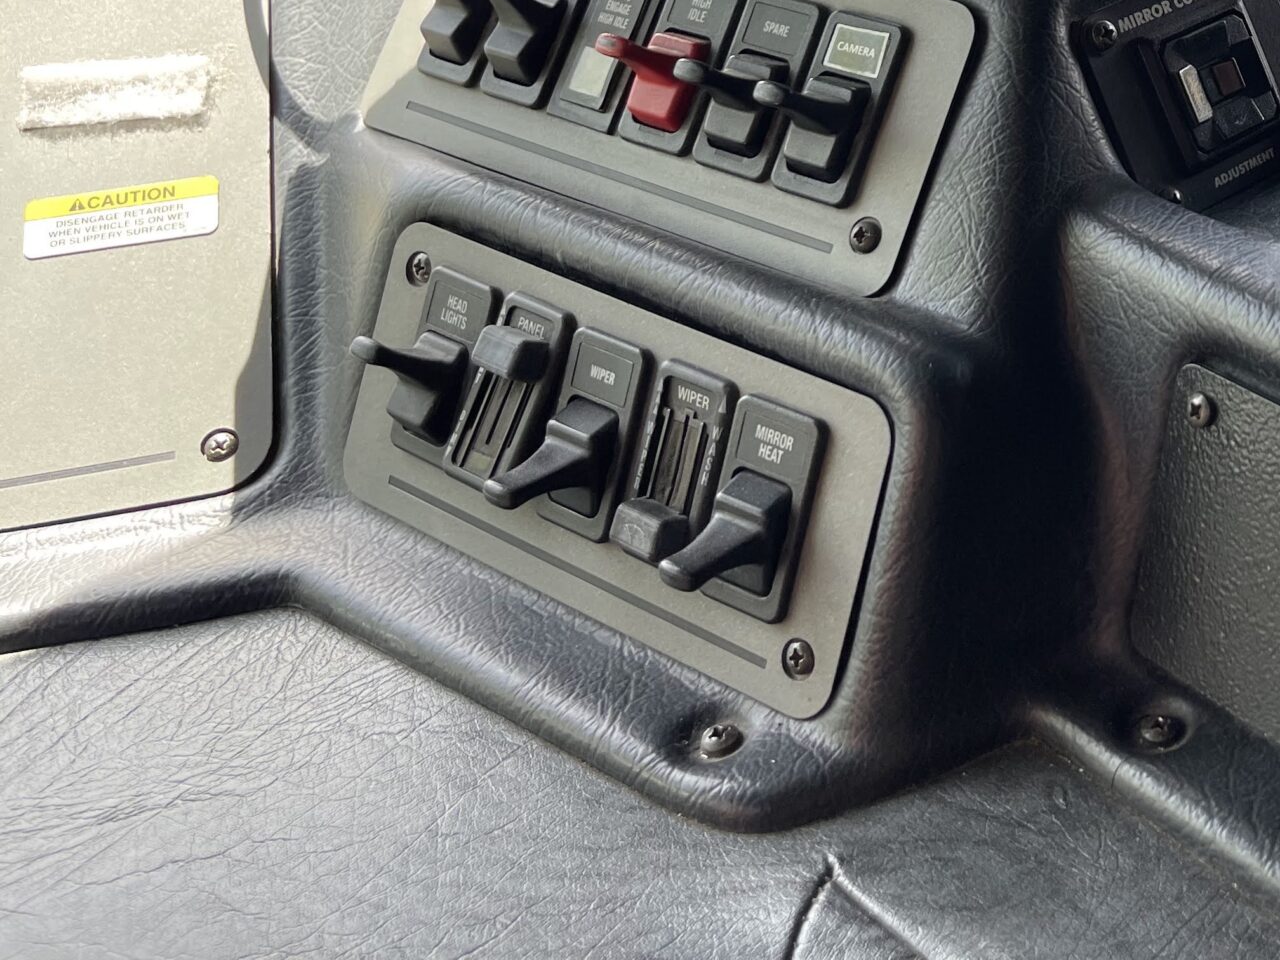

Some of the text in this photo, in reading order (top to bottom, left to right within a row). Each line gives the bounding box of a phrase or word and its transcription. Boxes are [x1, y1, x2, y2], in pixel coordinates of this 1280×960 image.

[605, 0, 633, 16] ENGAGE
[687, 9, 708, 23] IDLE
[1117, 0, 1173, 34] MIRROR
[598, 11, 630, 30] HIGH IDLE
[763, 20, 791, 38] SPARE
[836, 40, 876, 59] CAMERA
[1214, 147, 1276, 189] ADJUSTMENT
[87, 185, 177, 209] CAUTION
[48, 211, 191, 239] WHEN VEHICLE IS ON WET
[56, 203, 184, 229] DISENGAGE RETARDER
[50, 221, 187, 248] OR SLIPPERY SURFACES
[447, 294, 468, 314] HEAD
[440, 307, 468, 330] LIGHTS
[517, 315, 546, 340] PANEL
[589, 363, 617, 386] WIPER
[677, 384, 711, 411] WIPER
[754, 423, 794, 451] MIRROR
[634, 420, 656, 490] WIPER
[700, 425, 724, 487] WASH
[757, 444, 784, 465] HEAT
